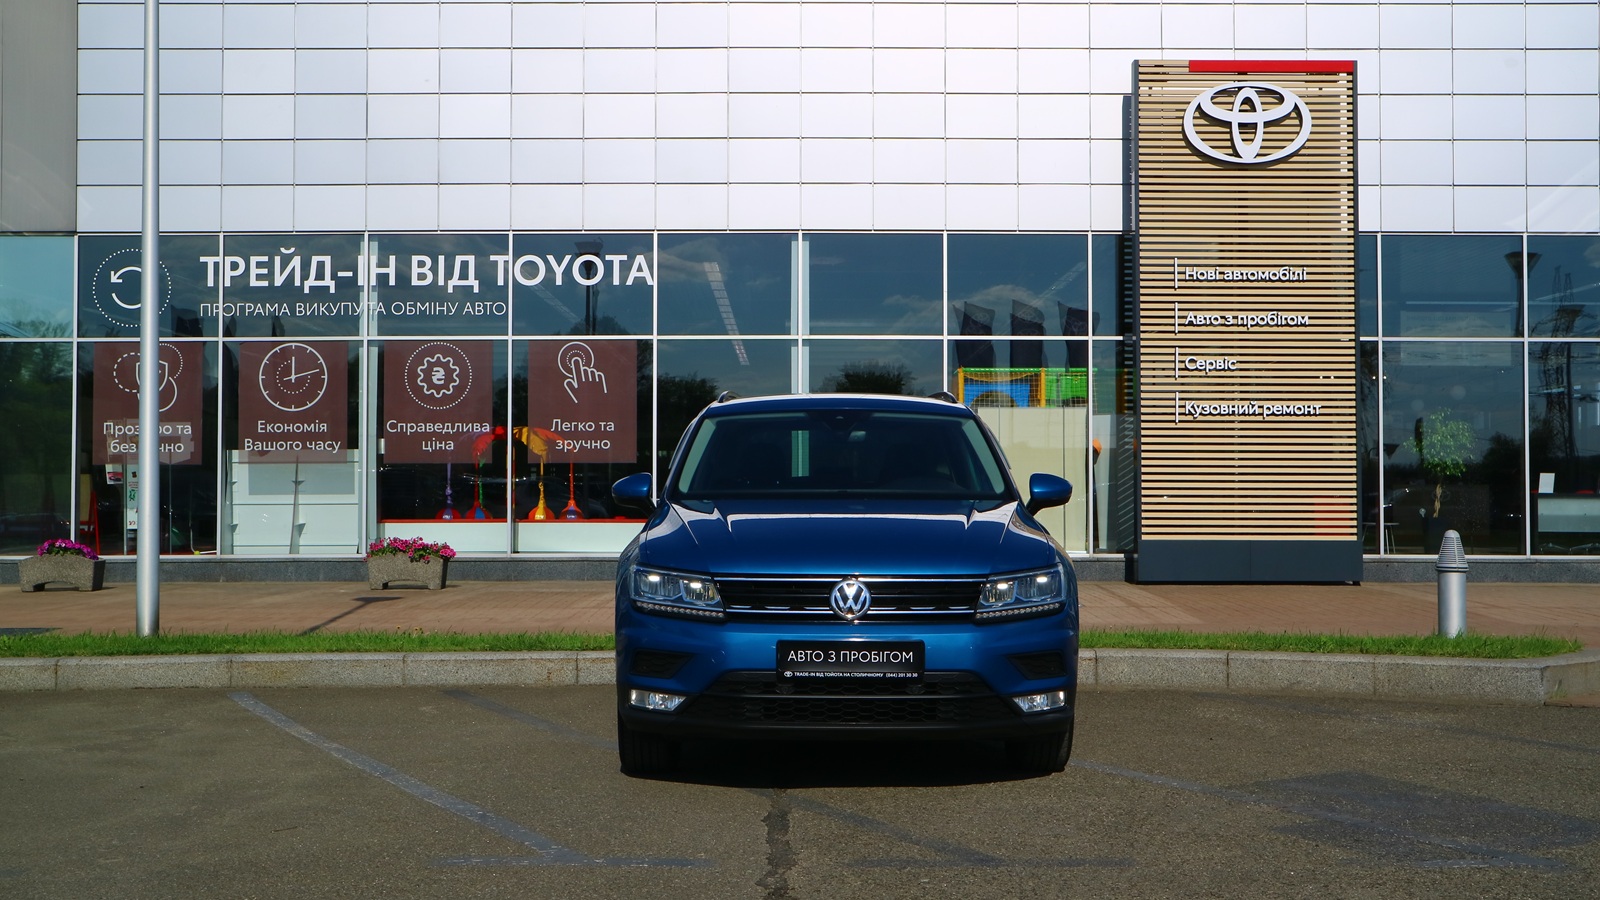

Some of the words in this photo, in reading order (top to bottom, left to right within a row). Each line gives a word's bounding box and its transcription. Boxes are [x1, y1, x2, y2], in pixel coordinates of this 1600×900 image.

[199, 247, 396, 294] ТРЕЙД-ІН
[411, 254, 480, 294] ВІД
[489, 254, 654, 287] TOYOTA
[1185, 267, 1220, 281] Нові
[1223, 266, 1307, 281] автомобілі
[199, 303, 291, 317] ПРОГРАМА
[295, 303, 364, 317] ВИКУПУ
[366, 302, 387, 316] ТА
[391, 302, 459, 317] ОБМІНУ
[462, 302, 507, 316] АВТО
[1185, 312, 1222, 326] Авто
[1225, 315, 1234, 326] з
[1237, 311, 1310, 329] пробігом
[1185, 357, 1238, 373] Сервіс
[1185, 401, 1259, 418] Кузовний
[1262, 404, 1322, 418] ремонт
[176, 425, 192, 435] та
[257, 420, 328, 433] Економія
[386, 420, 491, 435] Справедлива
[550, 418, 595, 432] Легко
[598, 421, 615, 431] та
[244, 438, 303, 451] Вашого
[306, 440, 341, 453] часу
[422, 438, 454, 451] ціна
[555, 439, 611, 453] зручно
[787, 650, 824, 662] АВТО
[827, 651, 836, 662] З
[840, 651, 914, 663] ПРОБІГОМ
